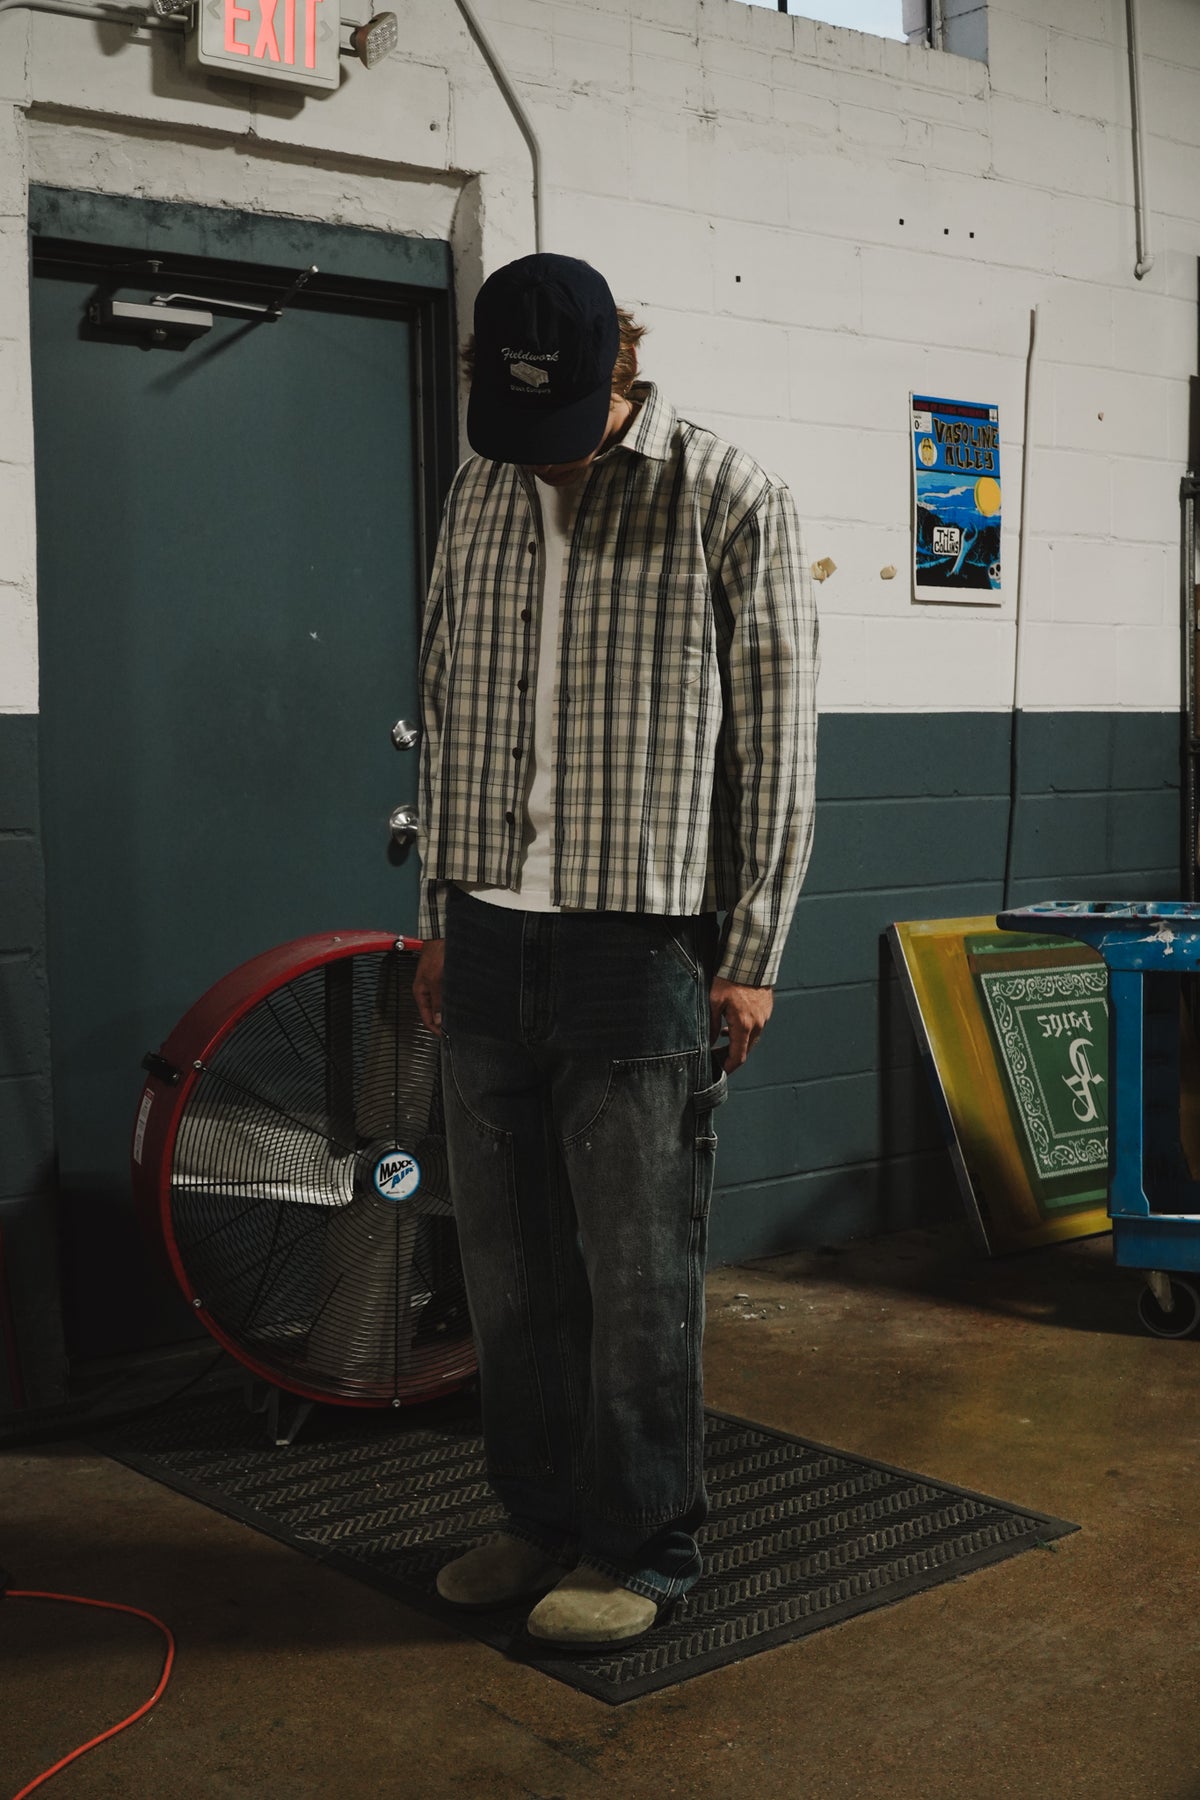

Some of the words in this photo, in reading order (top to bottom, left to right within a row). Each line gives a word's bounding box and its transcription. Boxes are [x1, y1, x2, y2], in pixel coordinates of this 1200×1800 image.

[224, 0, 323, 69] EXIT
[501, 347, 560, 361] Fieldwork
[932, 417, 999, 450] VASOLINE
[945, 445, 995, 471] ALLEY
[936, 529, 956, 542] THE
[380, 1160, 413, 1182] MAXX
